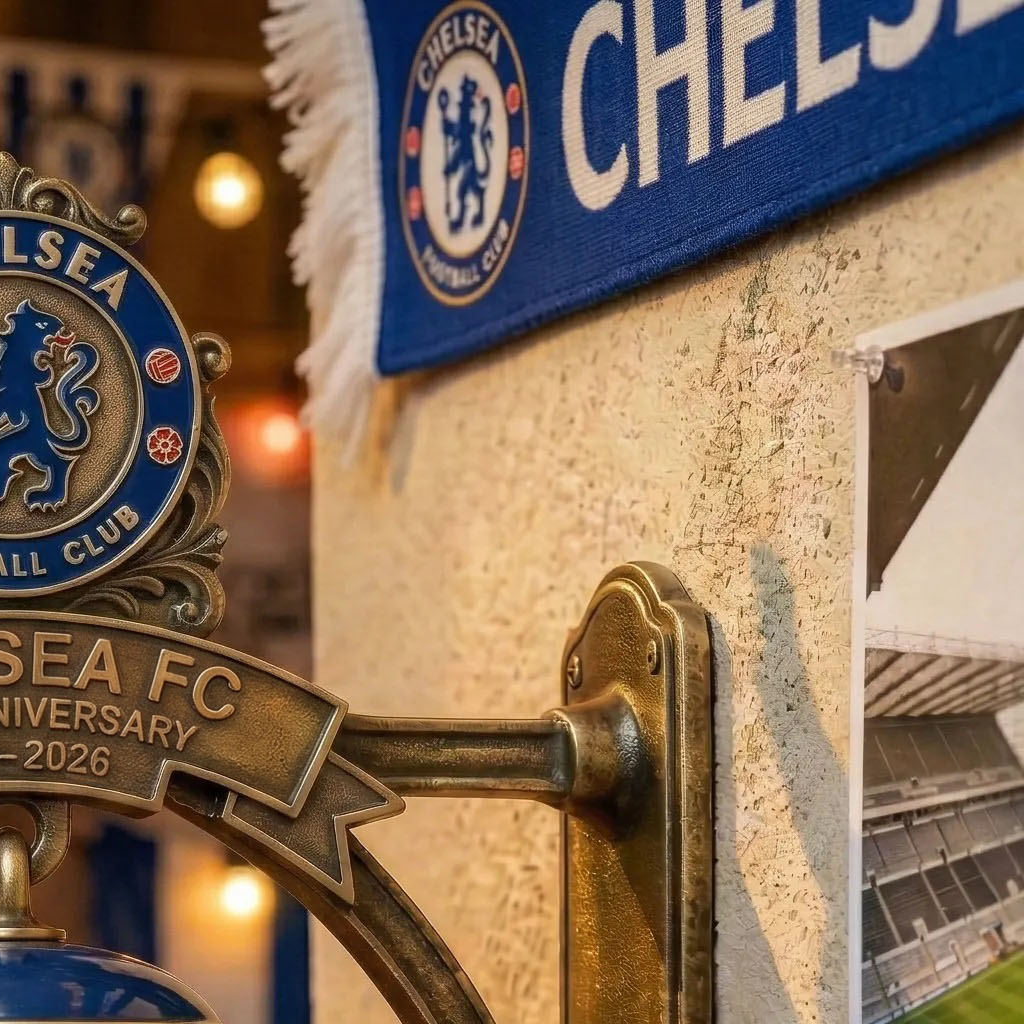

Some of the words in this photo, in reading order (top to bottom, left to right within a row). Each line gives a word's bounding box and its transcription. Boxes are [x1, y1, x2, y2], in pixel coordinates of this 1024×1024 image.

[416, 13, 500, 92] CHELSEA
[562, 0, 1024, 211] CHEL
[63, 504, 141, 565] CLUB
[147, 652, 243, 722] FC
